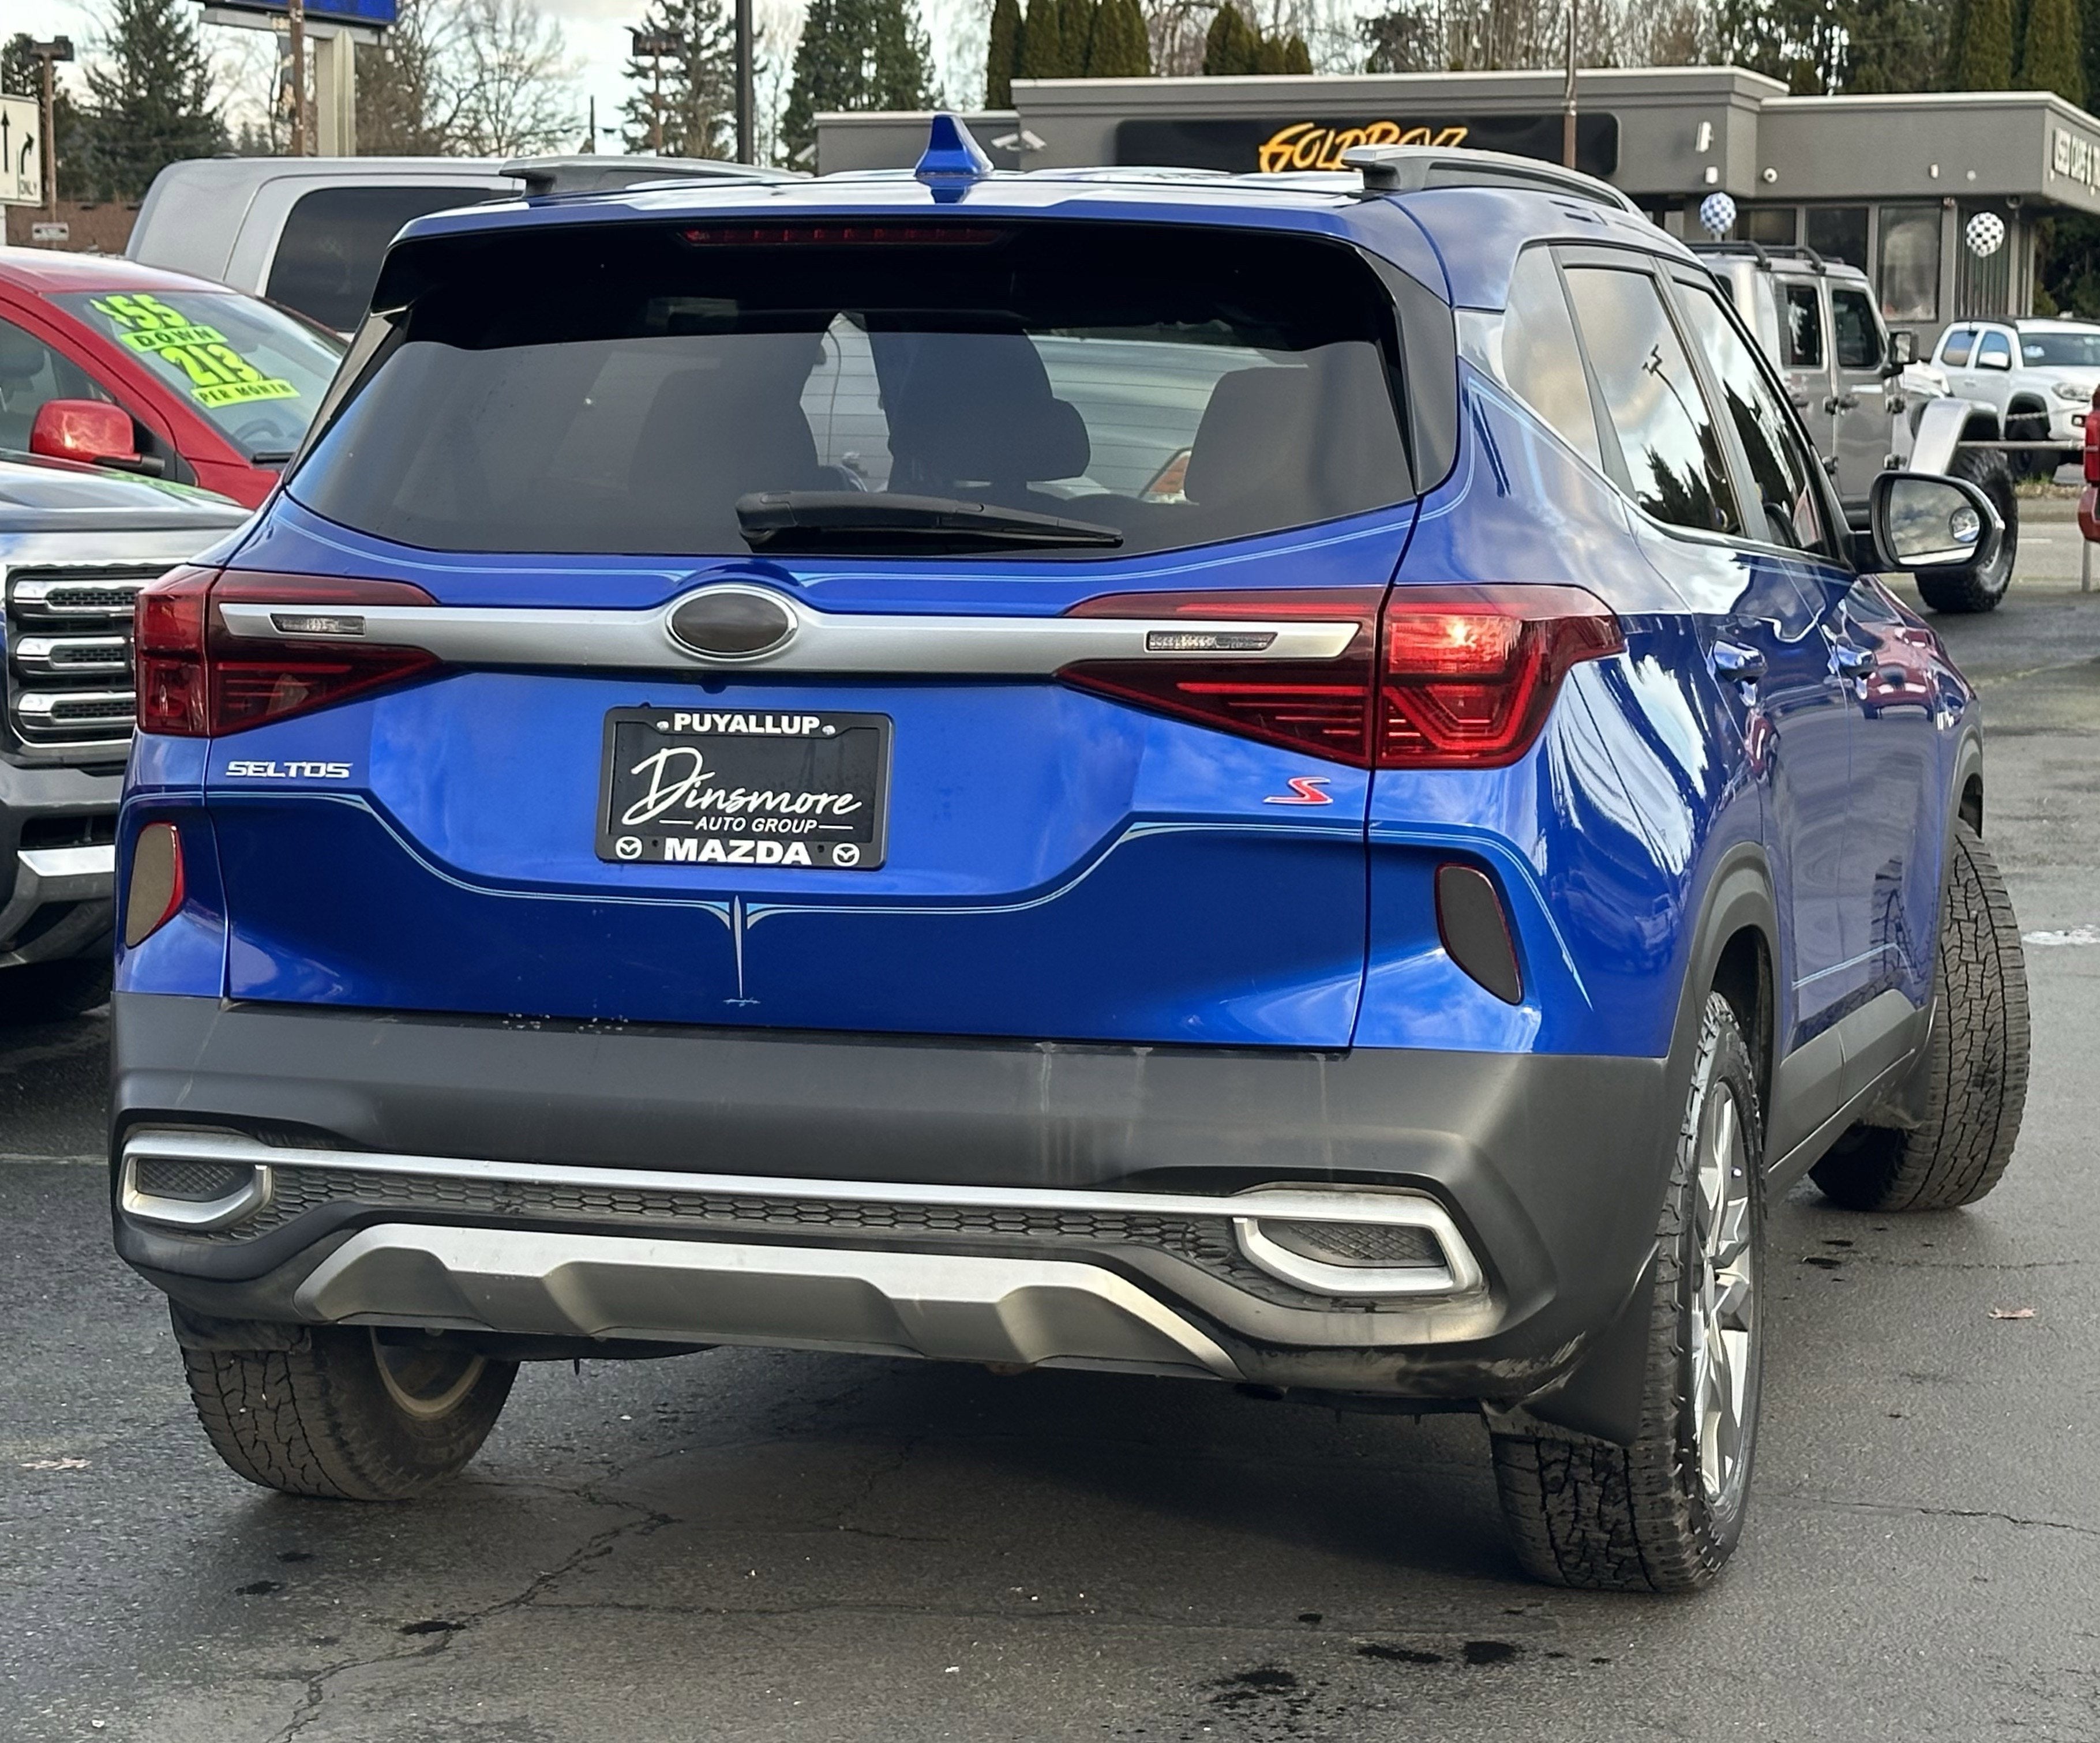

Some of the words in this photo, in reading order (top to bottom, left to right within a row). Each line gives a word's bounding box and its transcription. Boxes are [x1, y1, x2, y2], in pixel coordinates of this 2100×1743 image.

[134, 328, 216, 347] DOWN
[160, 344, 262, 386] 213
[198, 388, 232, 403] PER
[235, 383, 292, 396] MONTH
[674, 713, 820, 735] PUYALLUP
[226, 761, 353, 778] SELTOS
[621, 746, 862, 825] Dinsmore
[695, 816, 744, 832] AUTO
[751, 818, 817, 833] GROUP
[664, 838, 812, 866] MAZDA
